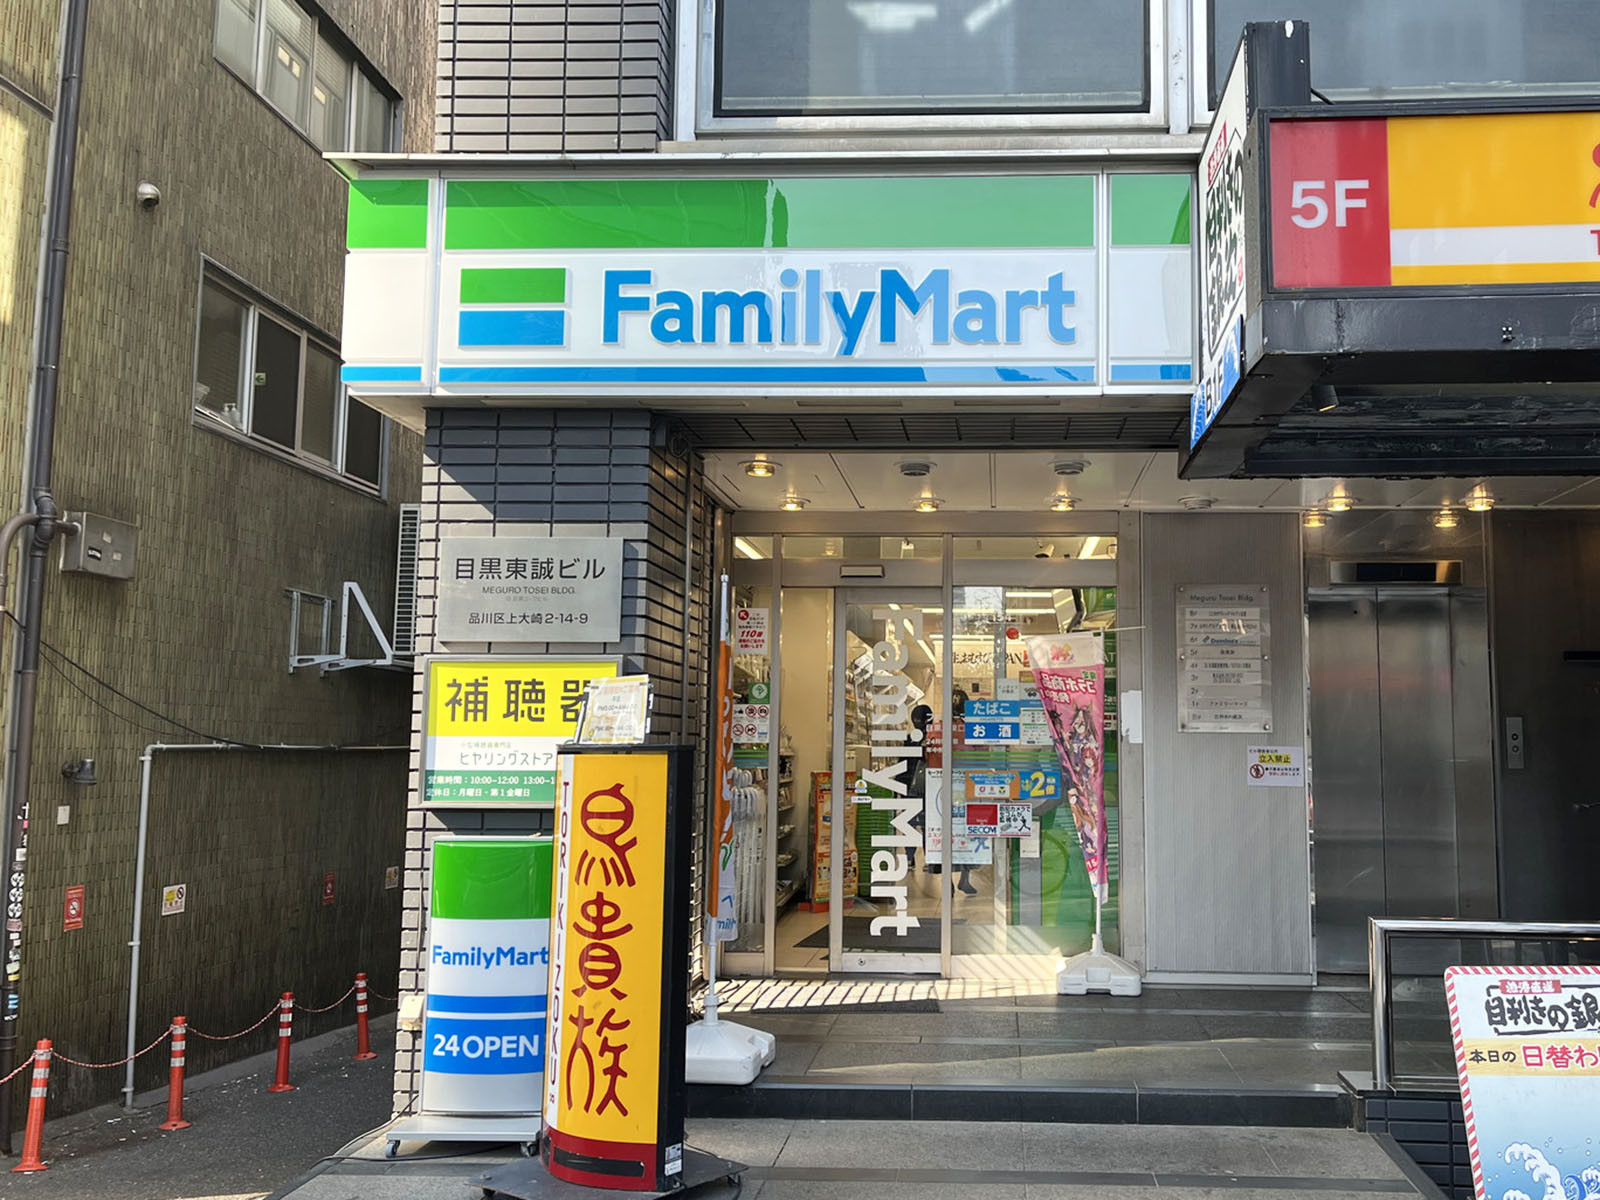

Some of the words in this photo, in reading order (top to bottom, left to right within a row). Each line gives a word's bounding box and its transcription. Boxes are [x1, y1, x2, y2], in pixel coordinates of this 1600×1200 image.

[1290, 179, 1369, 229] 5F
[603, 268, 1076, 356] FamilyMart
[1205, 357, 1224, 420] B1F
[455, 557, 606, 580] 目黒東誠ビル
[482, 586, 521, 594] MEGURO
[524, 586, 549, 594] TOSEI
[444, 676, 590, 722] 補聴器
[973, 702, 1011, 715] たばこ
[862, 608, 923, 936] FamilyMart
[967, 826, 997, 834] SECOM
[432, 945, 549, 969] FamilyMart
[565, 783, 638, 1118] 鳥貴族
[1468, 1049, 1517, 1064] 本日の
[1522, 1045, 1600, 1069] 日替わ
